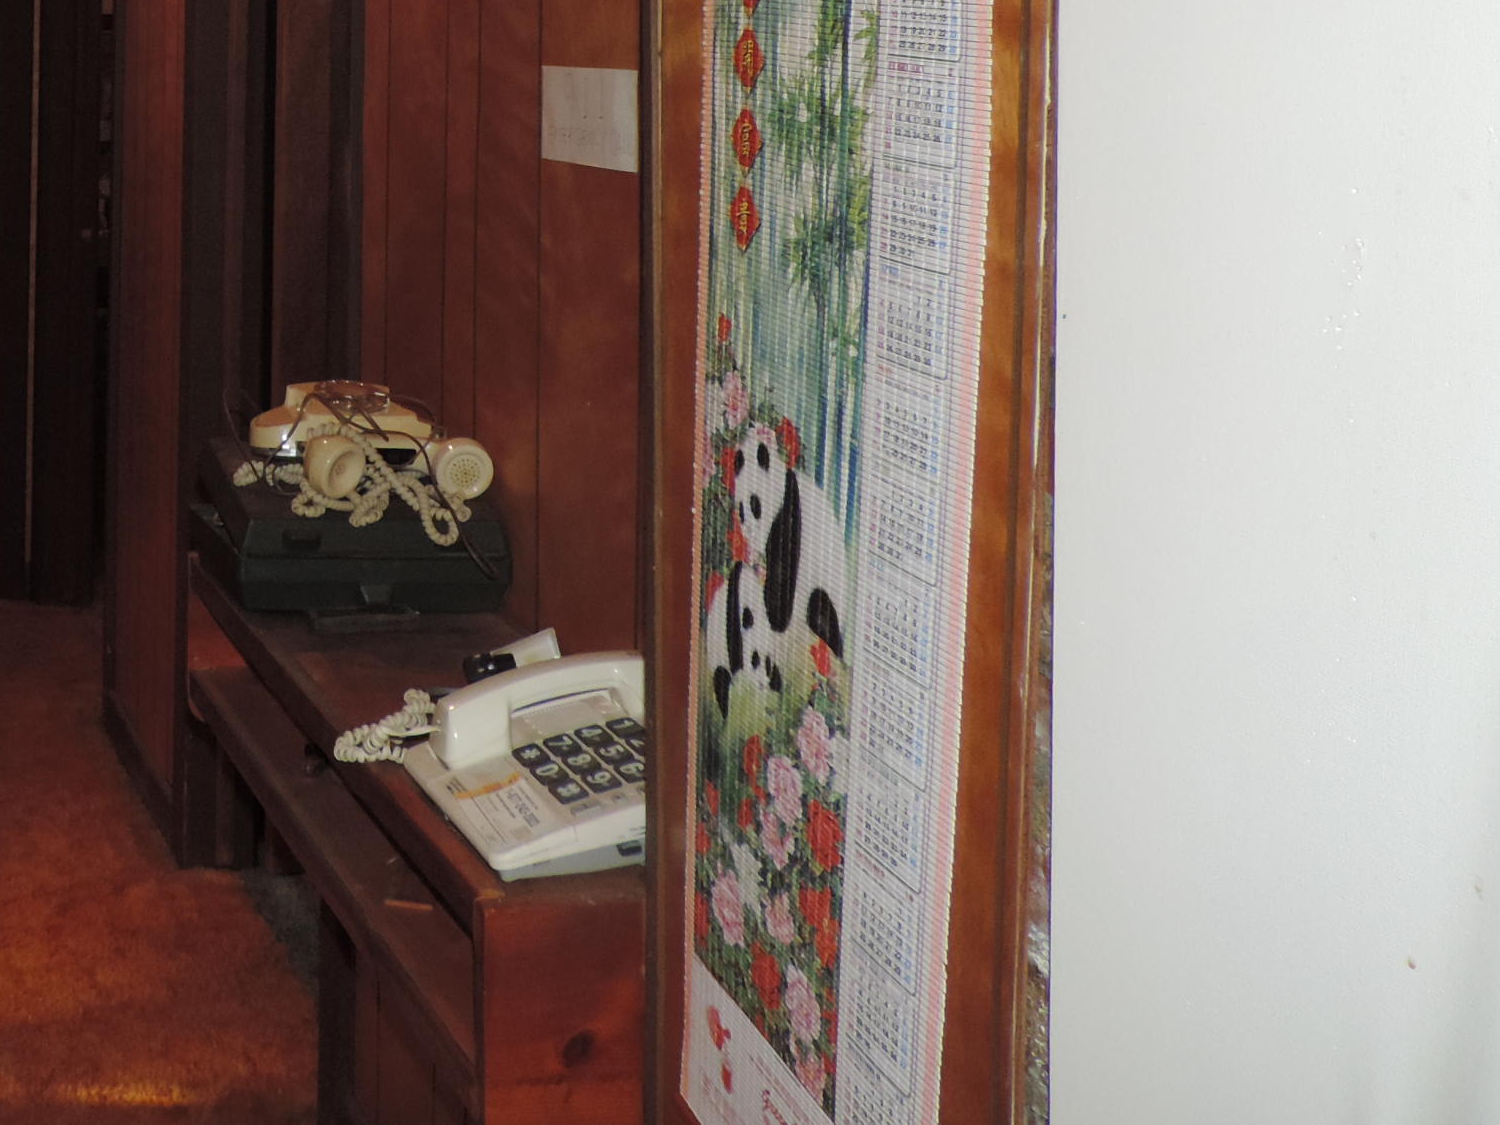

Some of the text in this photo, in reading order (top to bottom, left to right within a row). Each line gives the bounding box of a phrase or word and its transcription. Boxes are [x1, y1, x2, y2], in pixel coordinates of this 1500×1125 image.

[599, 744, 626, 756] 5
[547, 735, 612, 785] 7 8 9
[535, 762, 560, 777] 0
